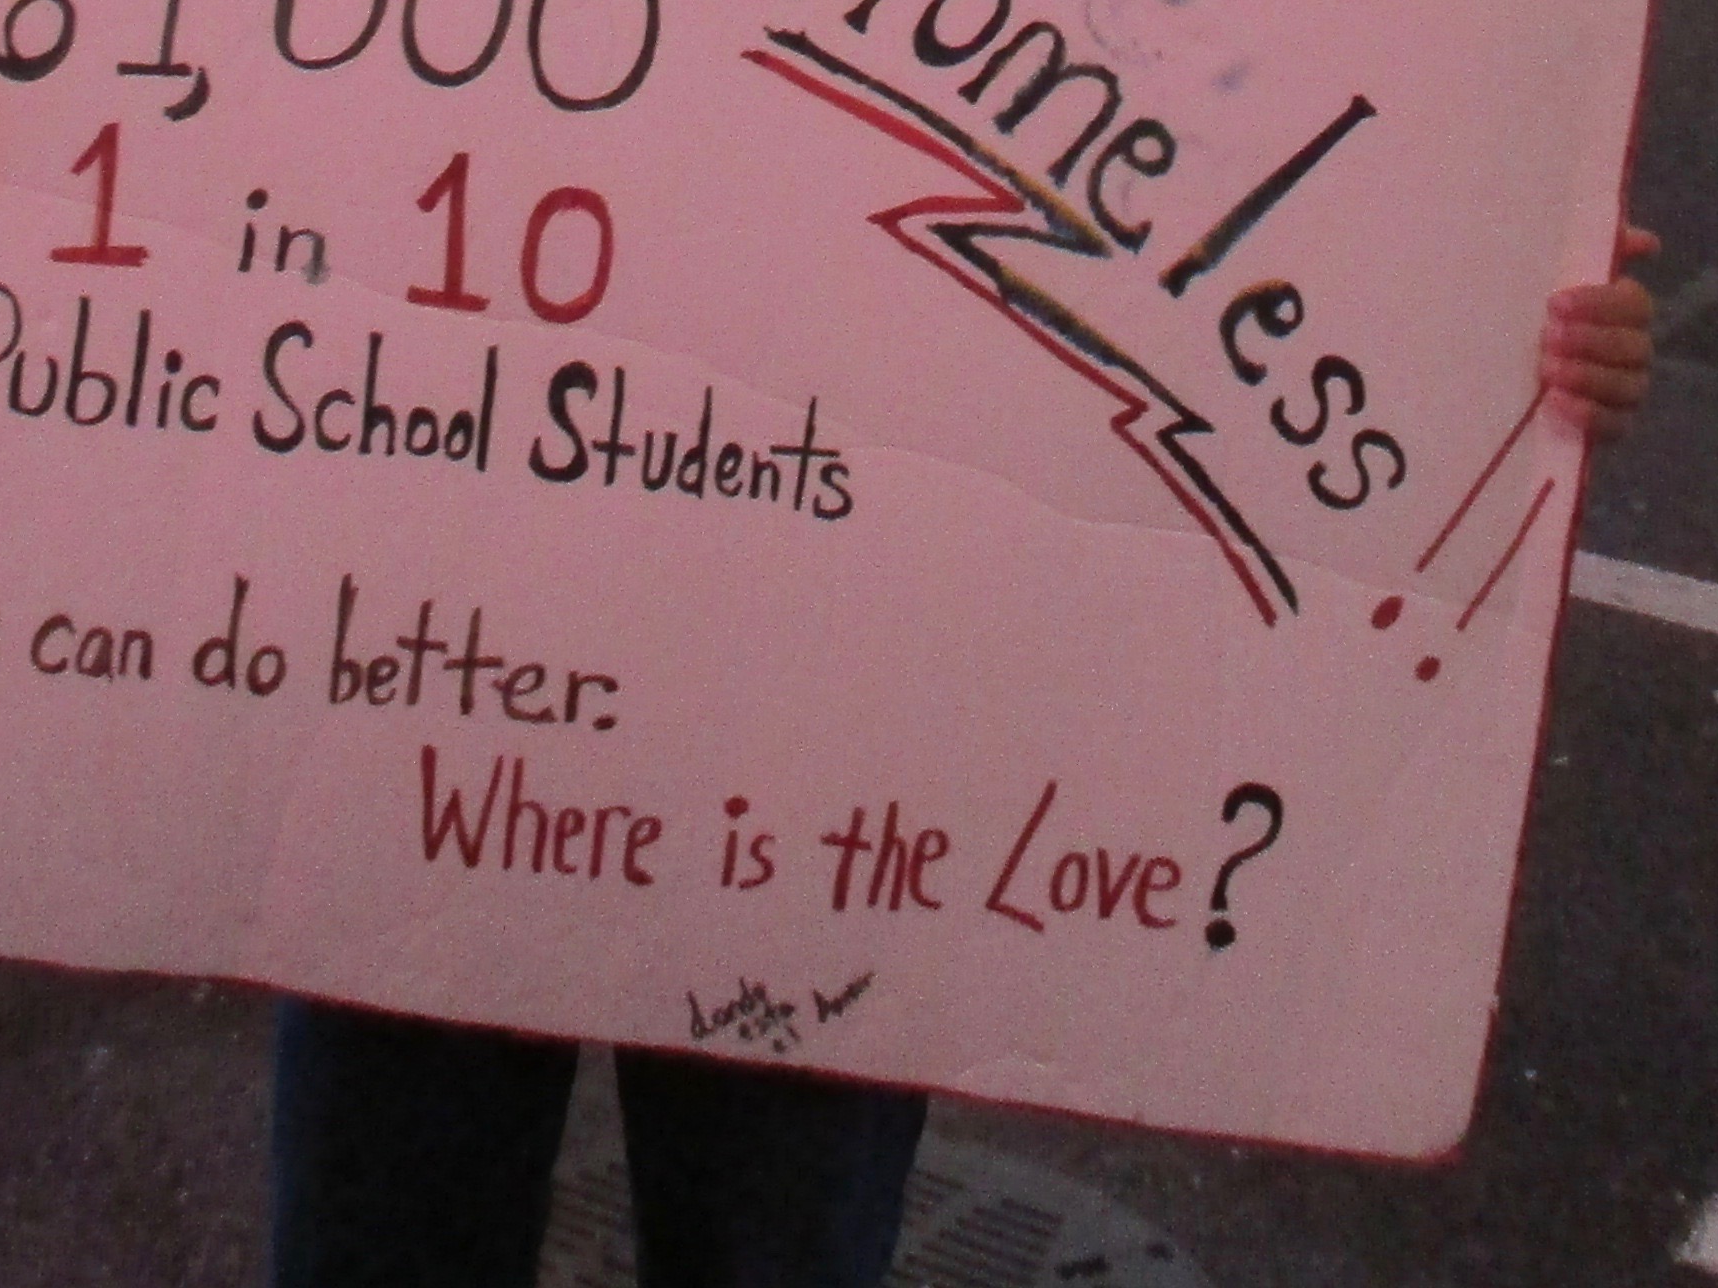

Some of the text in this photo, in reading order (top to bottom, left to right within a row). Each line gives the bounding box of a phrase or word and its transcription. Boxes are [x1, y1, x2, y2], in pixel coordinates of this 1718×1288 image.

[49, 123, 615, 324] 1 in 10
[252, 321, 499, 472] School
[528, 360, 854, 521] Students
[29, 613, 154, 681] can
[192, 575, 287, 699] do
[421, 744, 663, 887] Where
[720, 796, 776, 891] is
[820, 800, 950, 912] the
